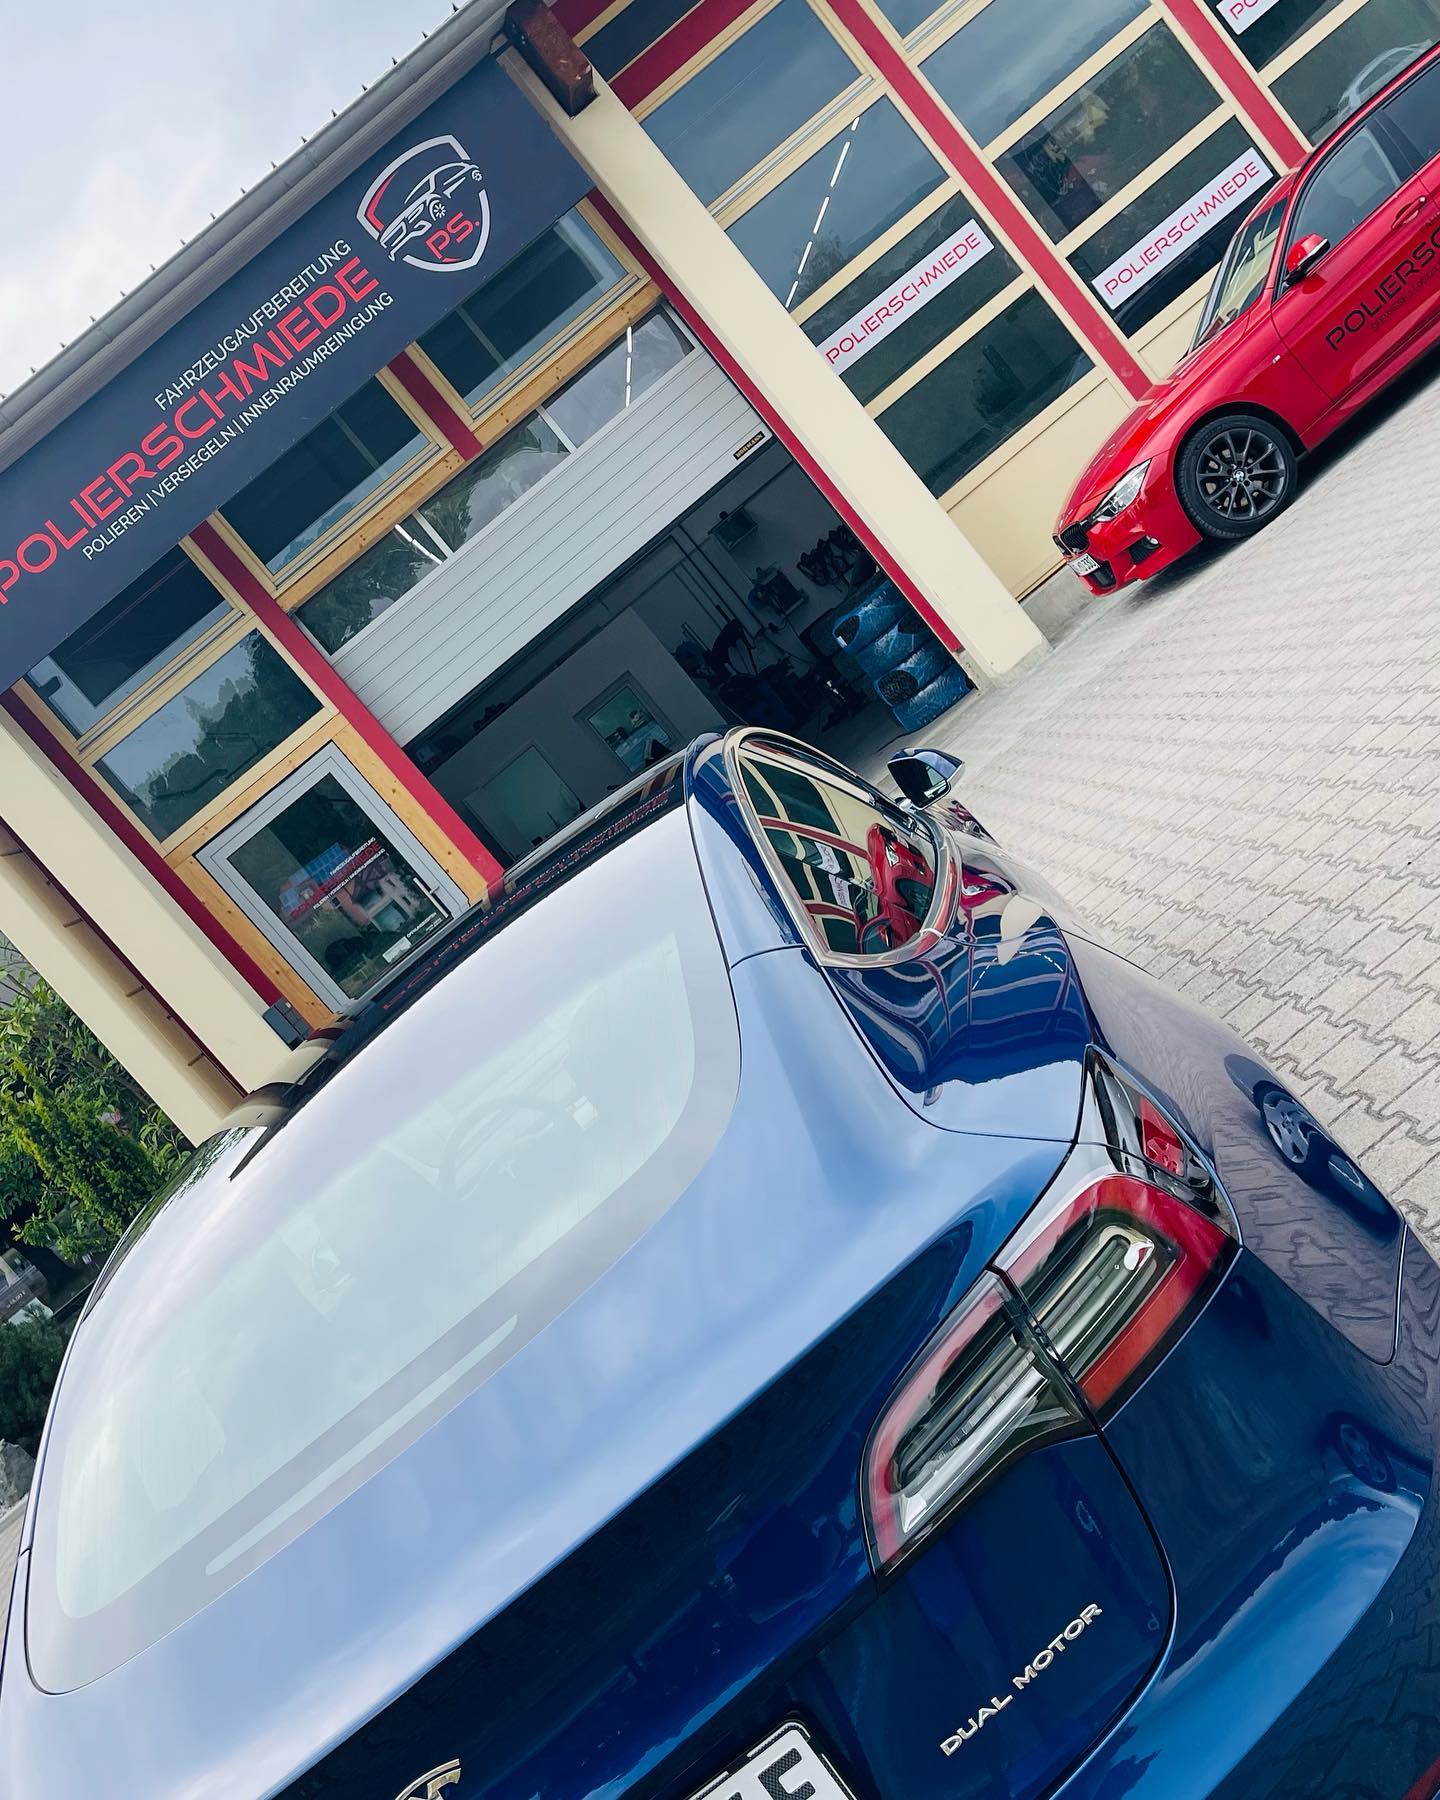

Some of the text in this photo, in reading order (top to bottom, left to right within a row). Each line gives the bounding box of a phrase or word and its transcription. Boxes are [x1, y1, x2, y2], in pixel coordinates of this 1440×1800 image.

[825, 232, 981, 364] POLIERSCHMIEDE
[1104, 161, 1260, 295] POLIERSCHMIEDE
[154, 239, 351, 411] FAHRZEUGAUFBEREITUNG
[0, 256, 379, 604] POLIERSCHMIEDE
[82, 292, 394, 560] POLIEREN VERSIEGELN INNENRAUMREINIGUNG
[940, 1603, 1102, 1756] DUAL MOTOR
